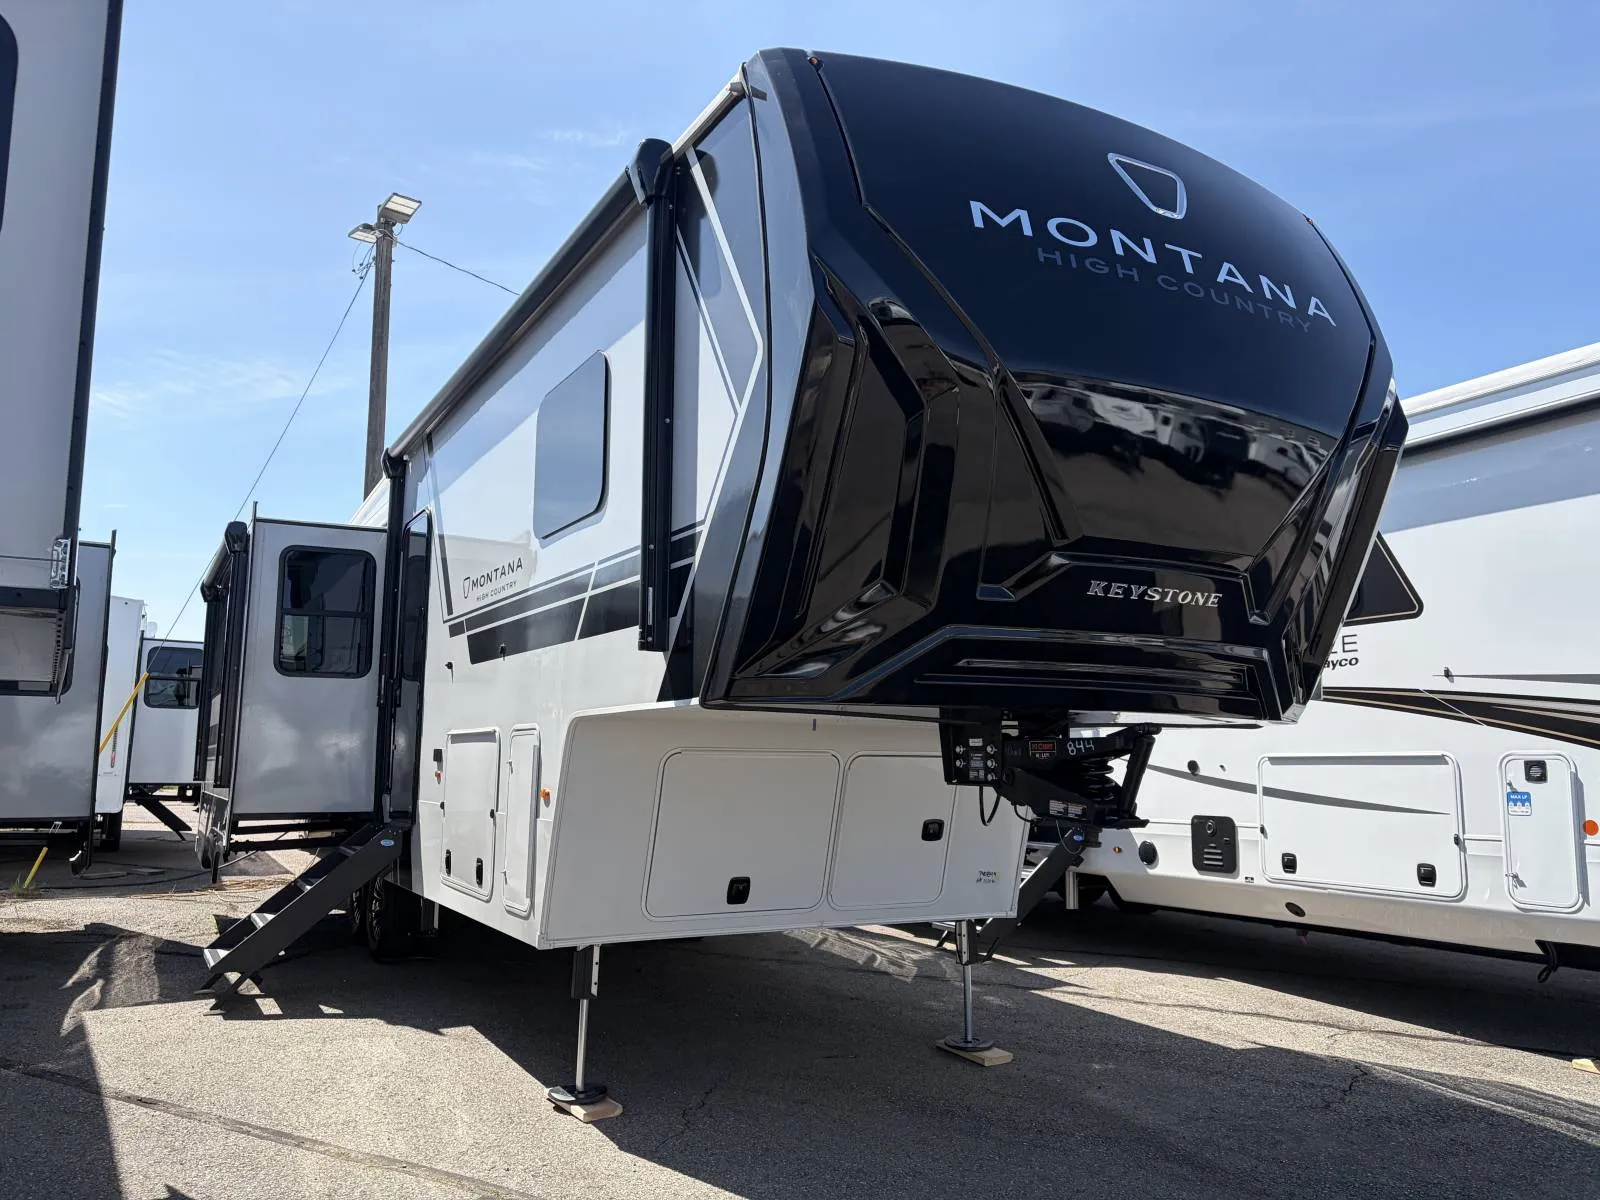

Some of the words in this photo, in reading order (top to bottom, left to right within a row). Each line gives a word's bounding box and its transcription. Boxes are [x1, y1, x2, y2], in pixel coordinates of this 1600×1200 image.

[969, 200, 1337, 327] MONTANA
[1036, 247, 1140, 283] HIGH
[1157, 275, 1312, 333] COUNTRY
[471, 557, 523, 591] MONTANA
[490, 581, 517, 596] COUNTRY
[1086, 580, 1223, 608] KEYSTONE
[1323, 657, 1359, 670] ayco
[1066, 739, 1095, 756] 844
